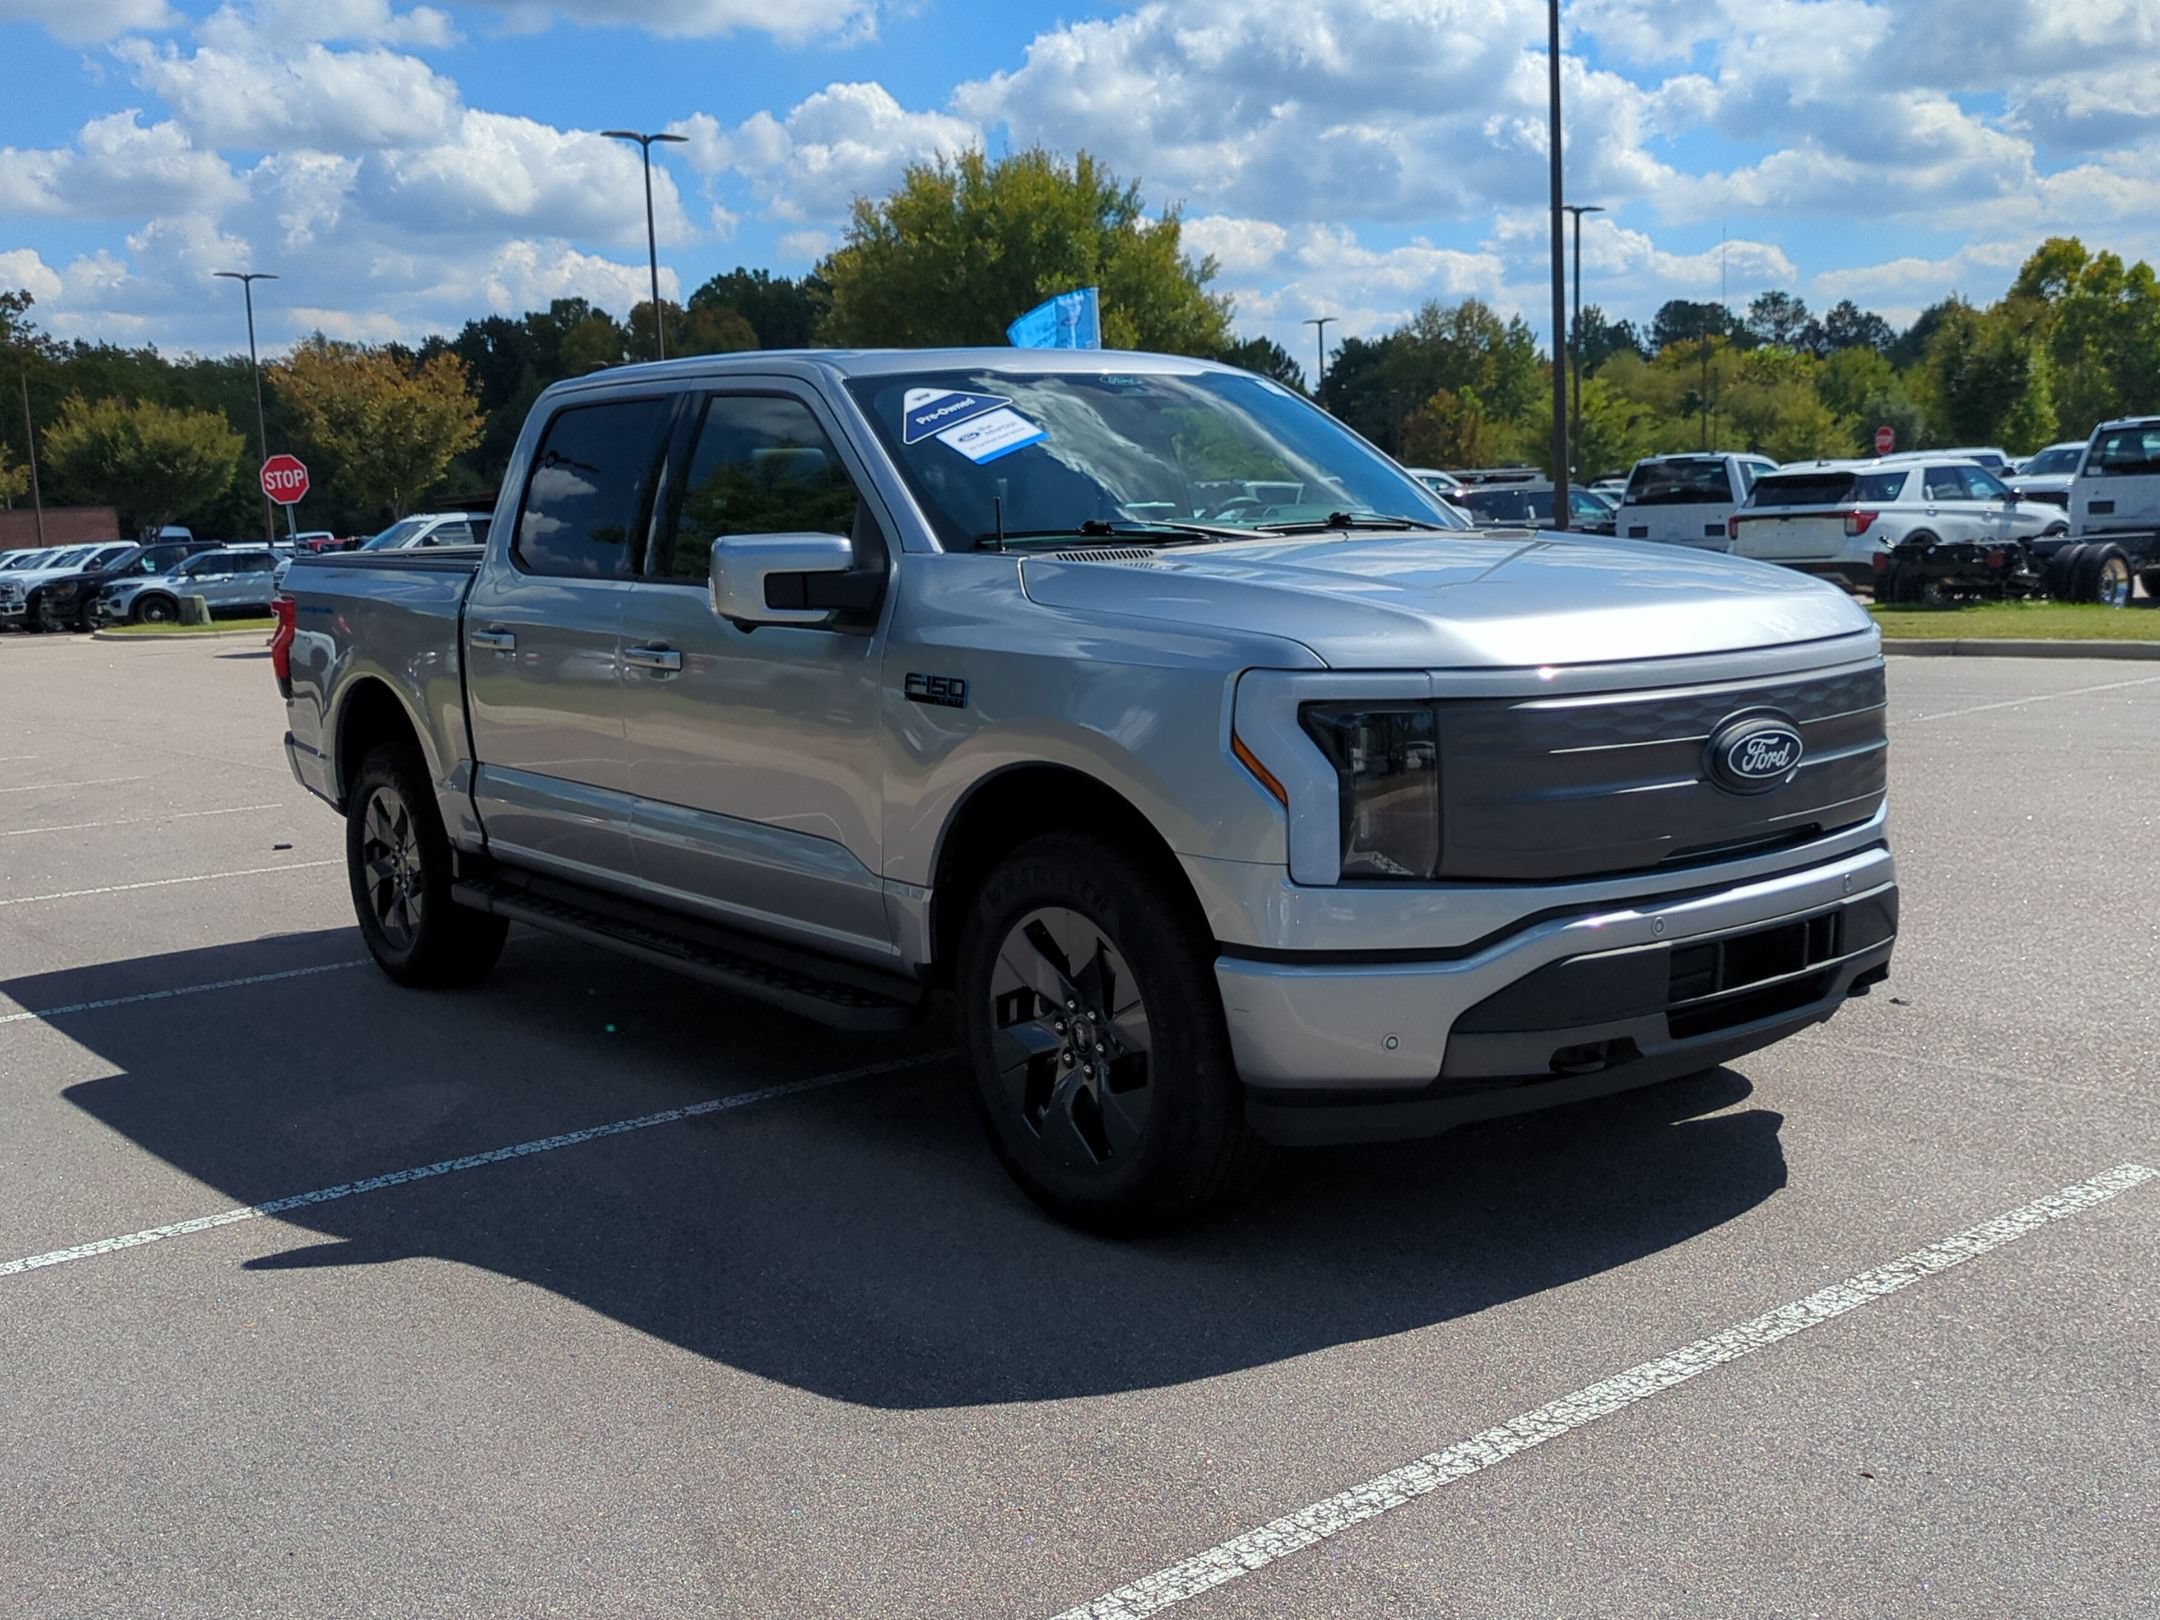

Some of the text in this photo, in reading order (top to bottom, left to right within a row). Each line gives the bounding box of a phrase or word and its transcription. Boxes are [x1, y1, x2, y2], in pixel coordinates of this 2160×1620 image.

[915, 397, 976, 425] Pre-Owned
[265, 469, 304, 490] STOP
[1742, 736, 1791, 772] Ford
